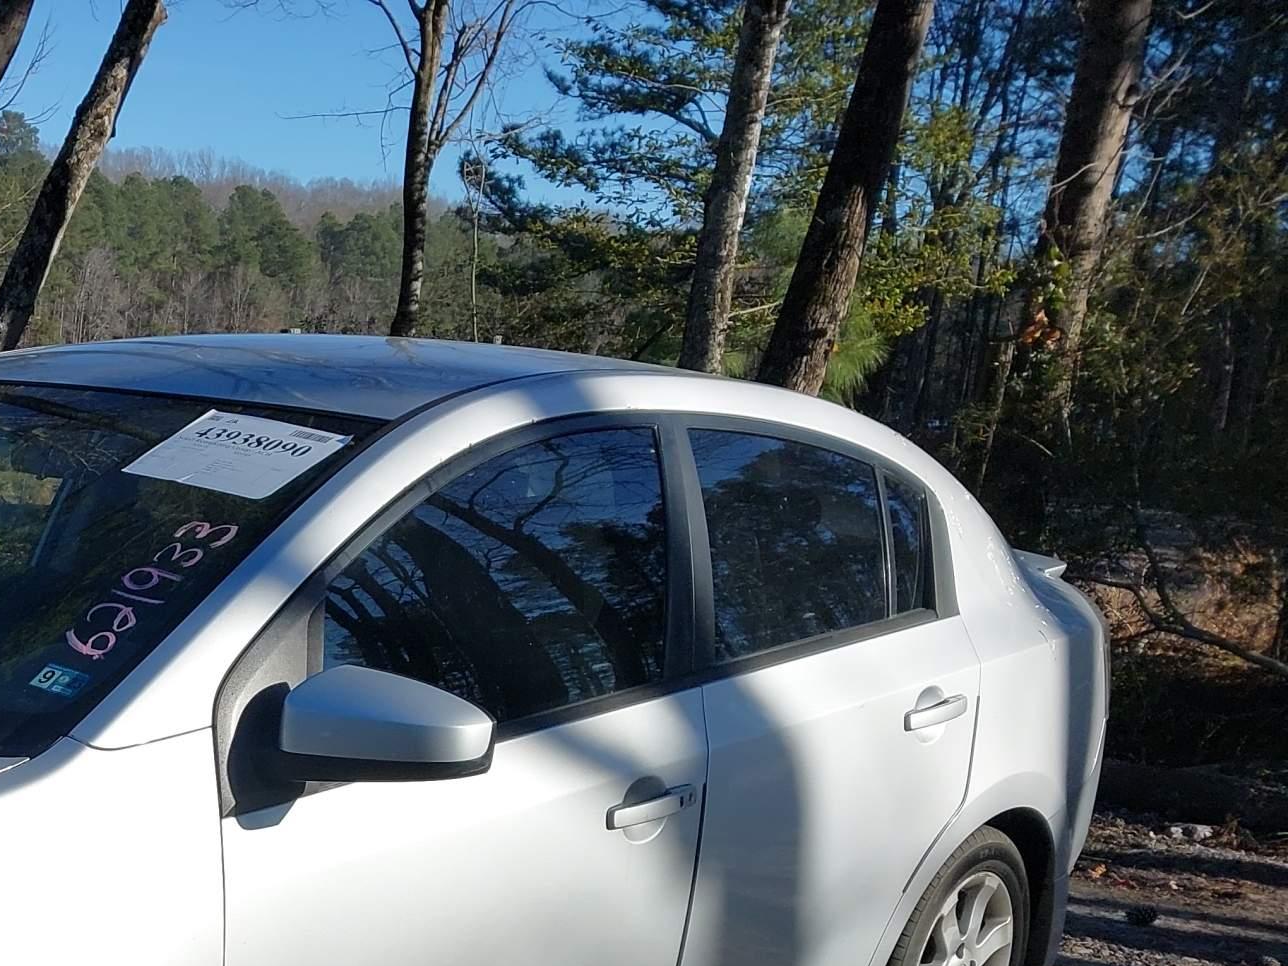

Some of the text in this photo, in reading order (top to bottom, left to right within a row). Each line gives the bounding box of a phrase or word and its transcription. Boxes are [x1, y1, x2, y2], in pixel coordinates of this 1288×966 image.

[195, 426, 313, 458] 43938090
[66, 521, 239, 660] 621933
[38, 670, 56, 683] 9
